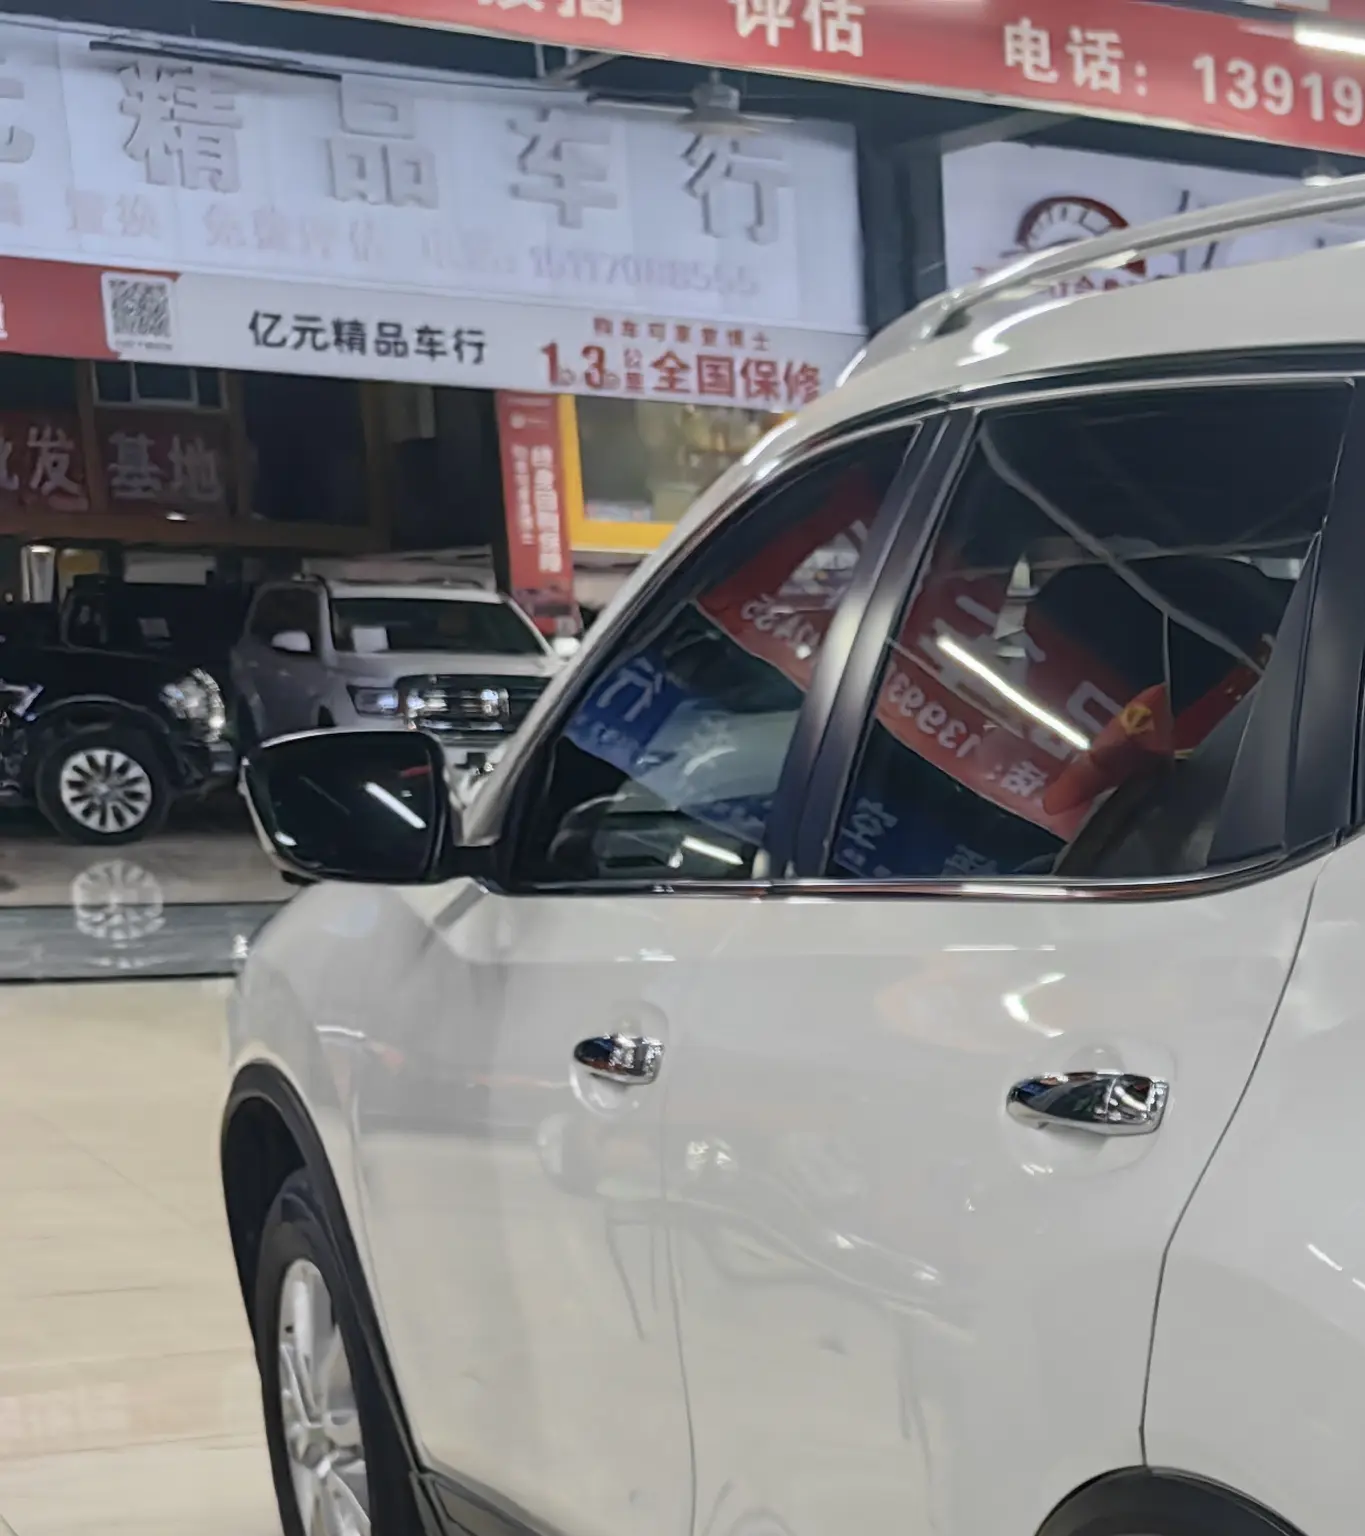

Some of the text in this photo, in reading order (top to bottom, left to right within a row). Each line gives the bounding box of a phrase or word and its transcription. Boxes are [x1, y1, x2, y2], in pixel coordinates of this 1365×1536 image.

[731, 0, 864, 57] 评估
[0, 52, 793, 246] 精品车行
[248, 310, 486, 365] 亿元精品车行
